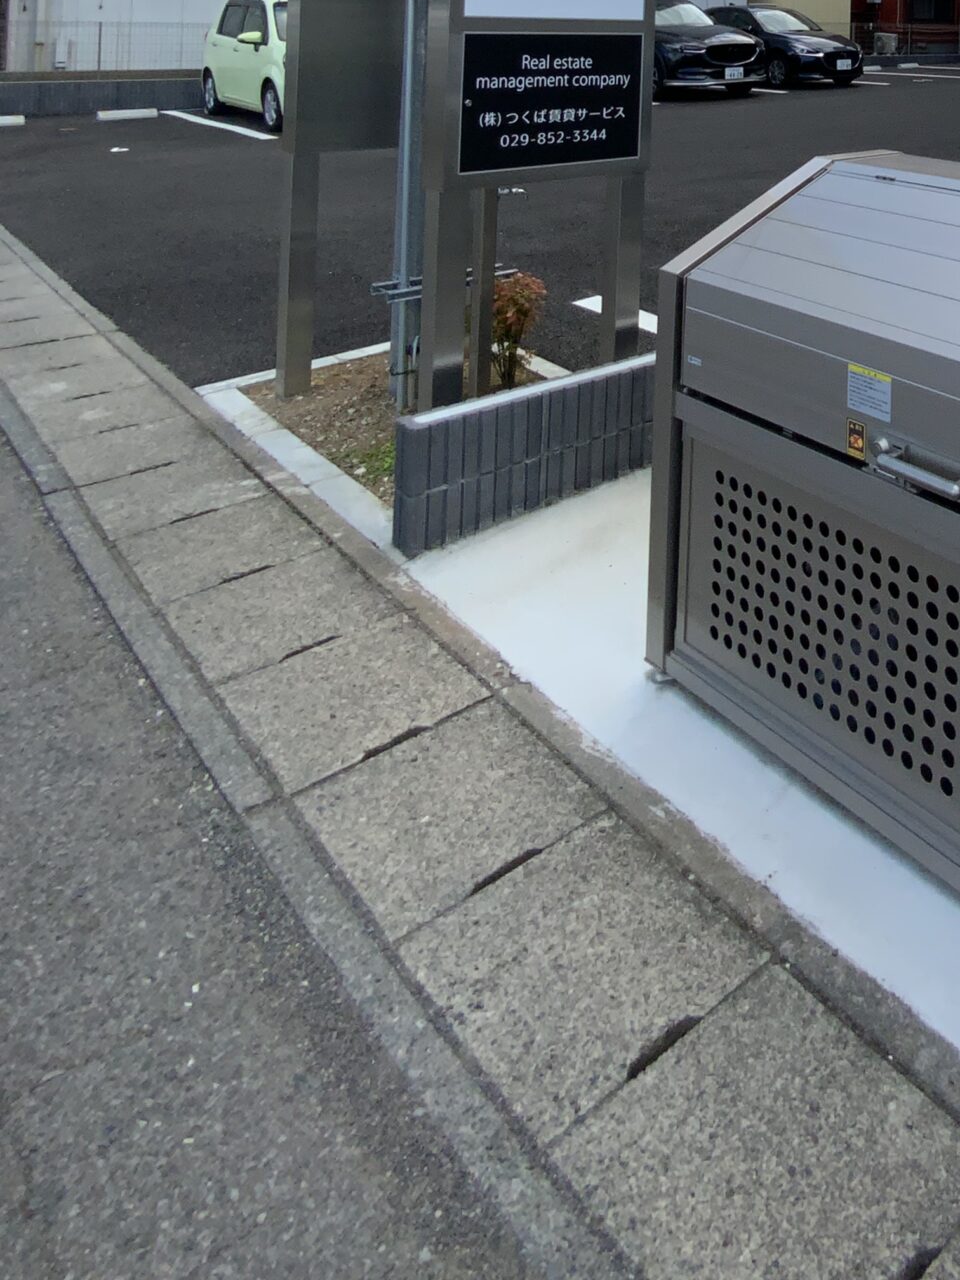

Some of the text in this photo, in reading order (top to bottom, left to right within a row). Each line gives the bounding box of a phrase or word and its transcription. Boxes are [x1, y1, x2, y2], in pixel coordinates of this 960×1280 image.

[521, 54, 593, 70] Real estate
[475, 74, 631, 91] management company
[500, 128, 607, 147] 029-852-3344
